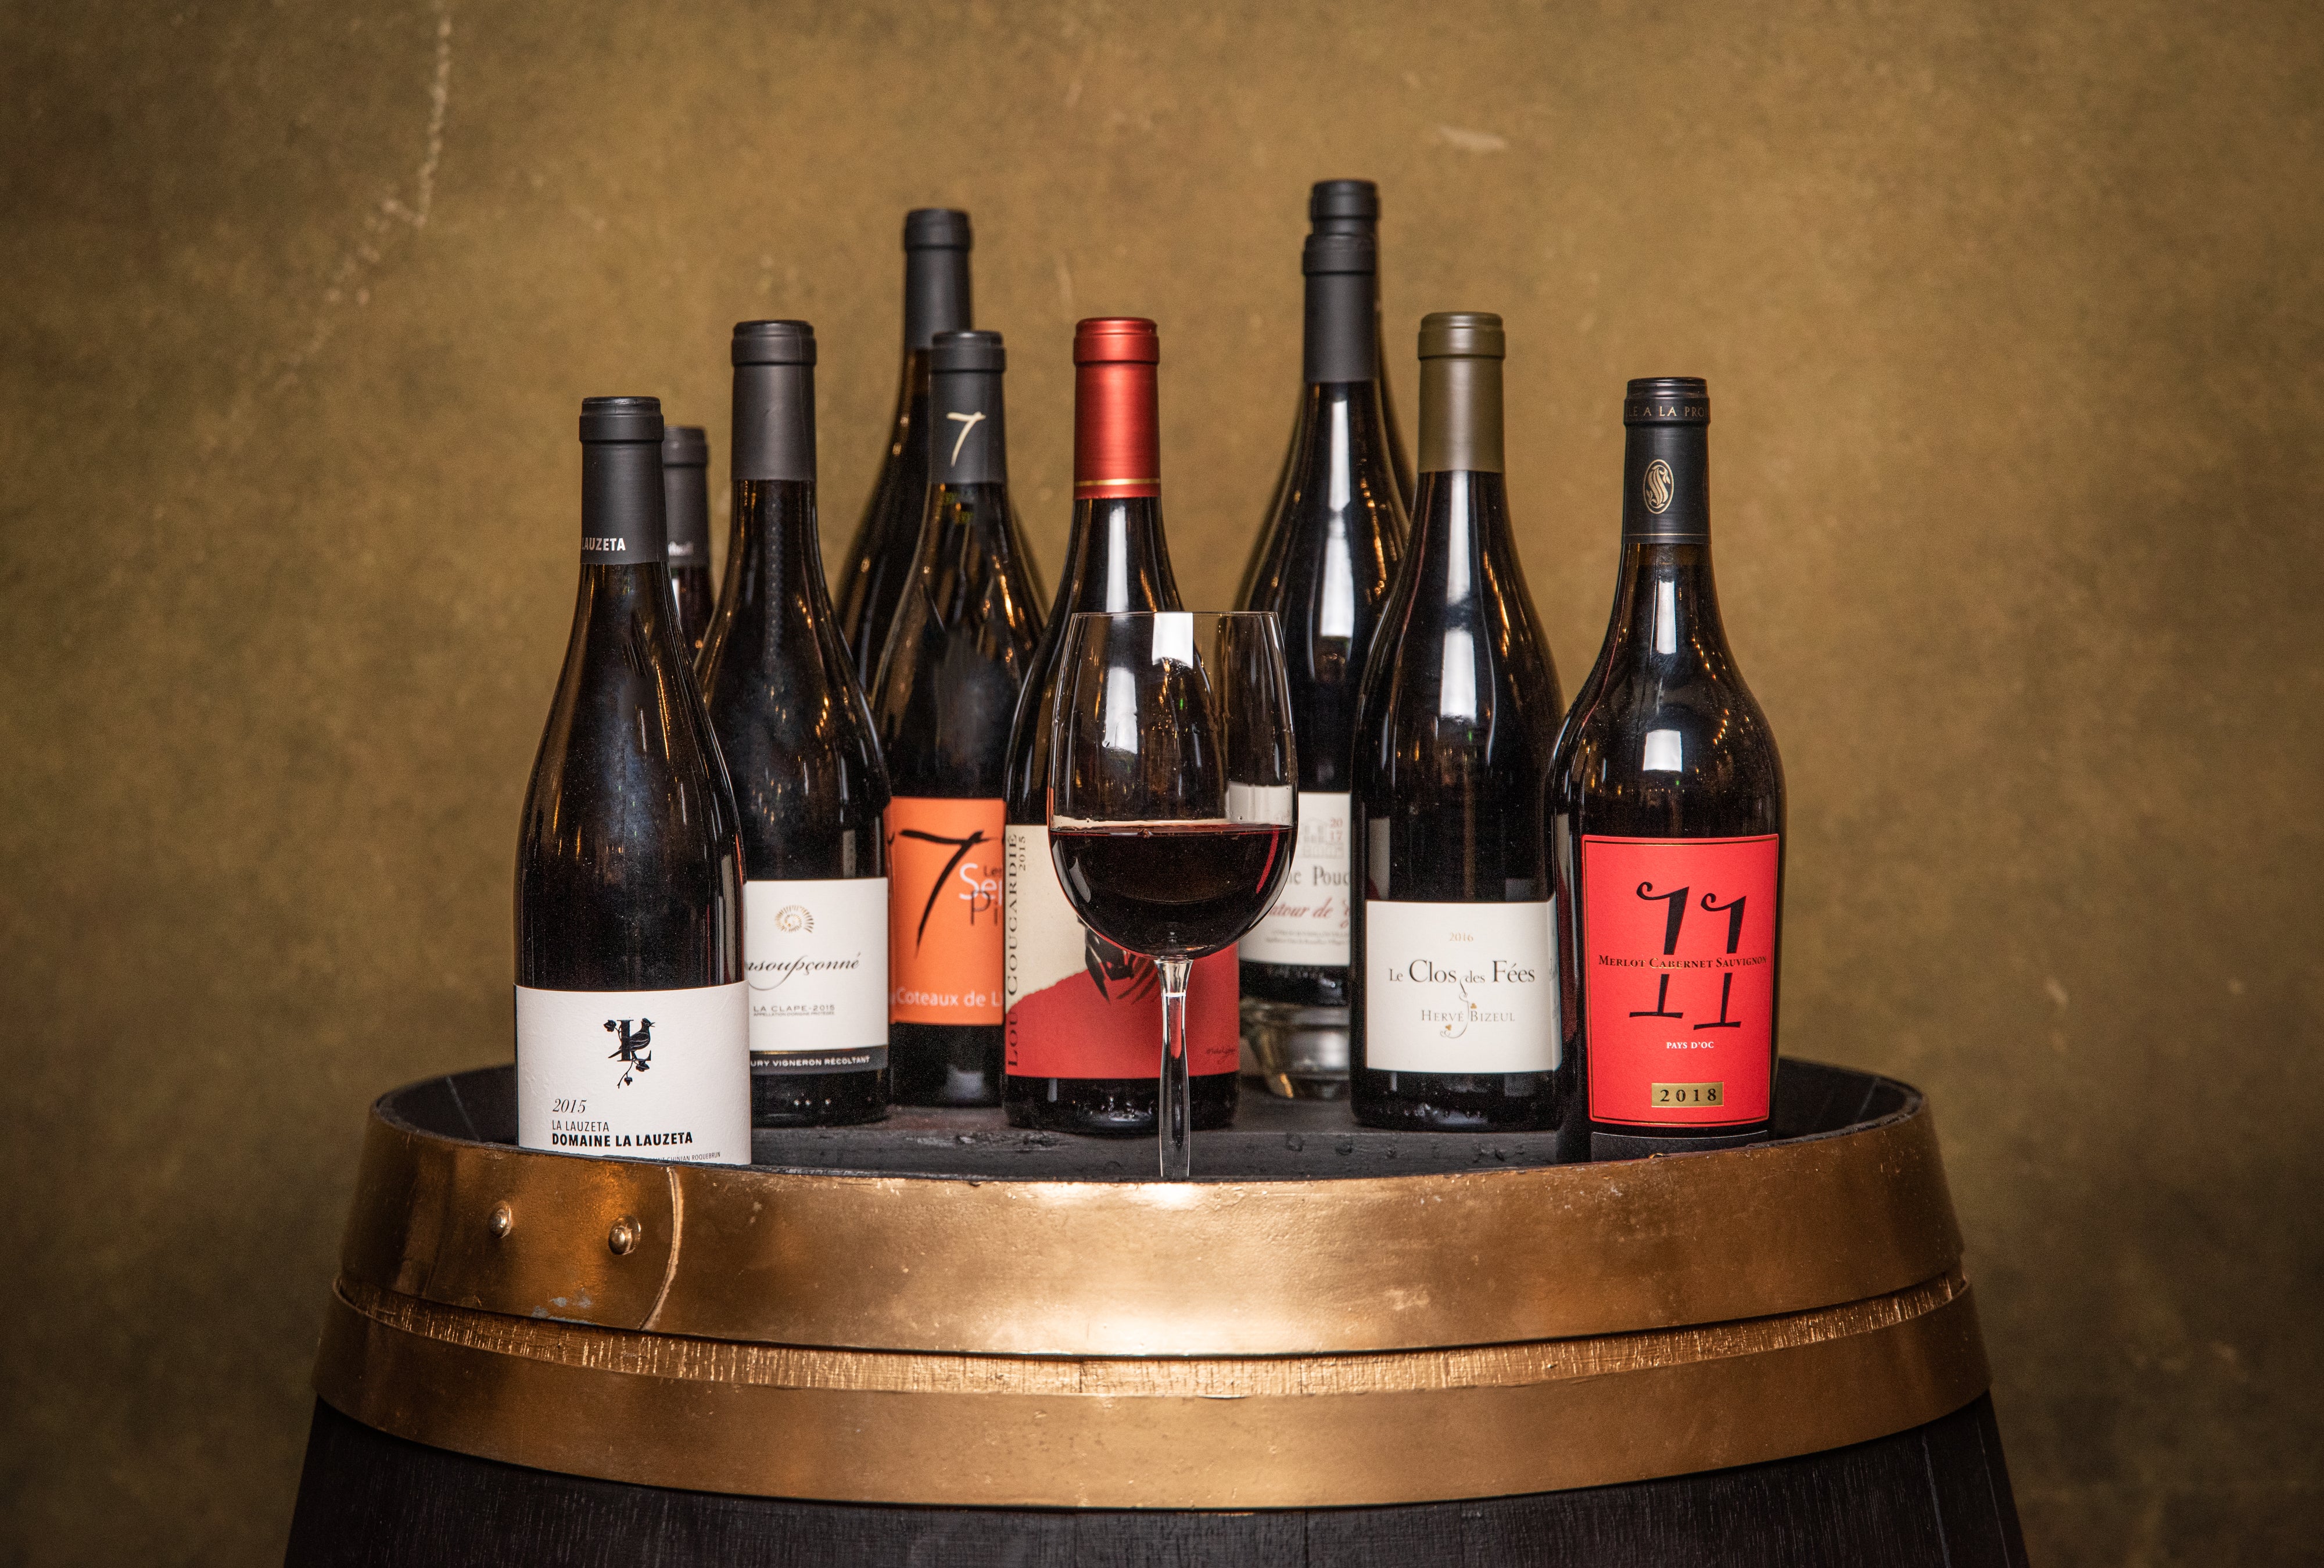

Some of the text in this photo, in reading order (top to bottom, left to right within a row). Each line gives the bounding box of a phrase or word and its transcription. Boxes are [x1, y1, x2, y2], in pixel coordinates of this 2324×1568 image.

[1659, 406, 1677, 416] LA
[946, 411, 986, 467] 7
[899, 829, 999, 959] 7
[1450, 932, 1474, 942] 2016
[1599, 955, 1767, 969] MERLOT CABERNET SAUVIGNON
[1389, 959, 1536, 983] Le Clos des Fées
[896, 987, 959, 1006] Coteaux
[963, 989, 987, 1007] de
[1422, 1009, 1516, 1022] HERVÉ BIZEUL
[1007, 1011, 1018, 1068] LOU
[1666, 1040, 1714, 1050] PAYS D'OC
[772, 1058, 822, 1067] VIGNERON
[824, 1056, 870, 1065] RÉCOLTANT
[1659, 1088, 1717, 1103] 2018
[553, 1098, 587, 1114] 2015
[552, 1120, 609, 1132] LA LAUZETA
[552, 1132, 693, 1147] DOMAINE LA LAUZETA
[691, 1151, 720, 1161] ROQUEBRUN
